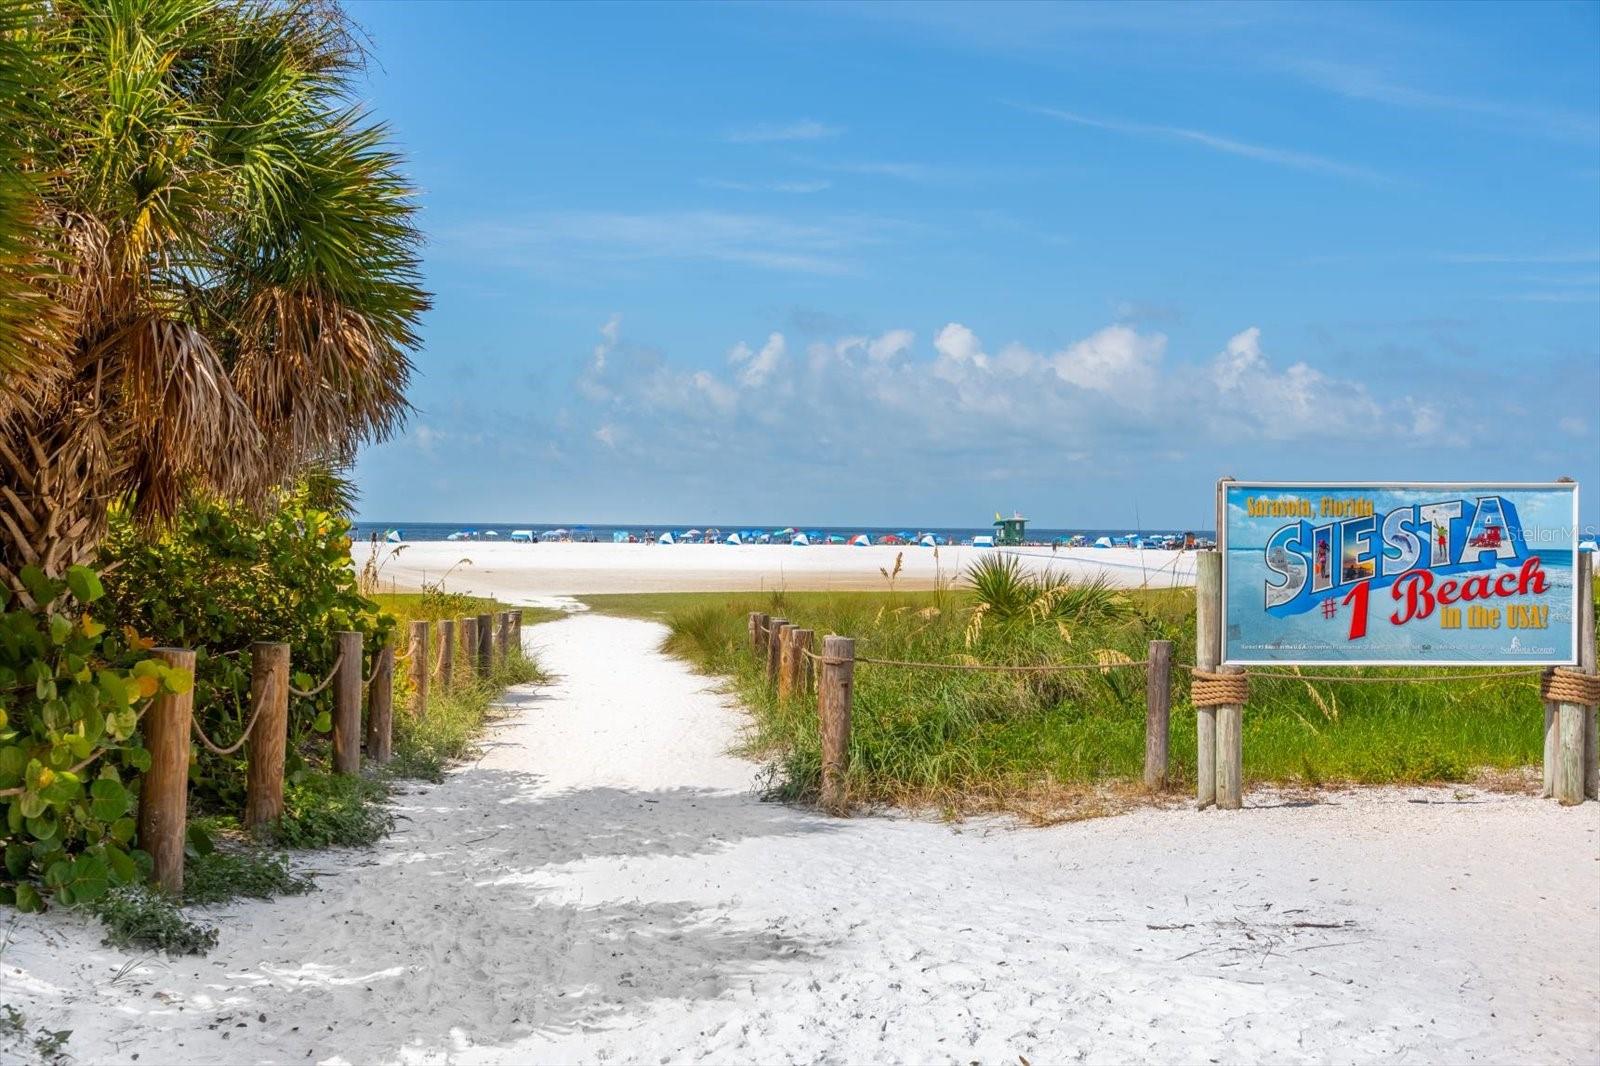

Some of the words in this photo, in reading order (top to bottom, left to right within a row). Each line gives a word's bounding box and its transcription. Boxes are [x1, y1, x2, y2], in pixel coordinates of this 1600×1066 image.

[1247, 496, 1316, 519] Sarasota,
[1320, 496, 1374, 517] Florida
[1265, 496, 1516, 612] SIESTA
[1390, 556, 1551, 626] Beach
[1440, 605, 1462, 629] in
[1467, 605, 1501, 629] the
[1507, 604, 1549, 629] USA!
